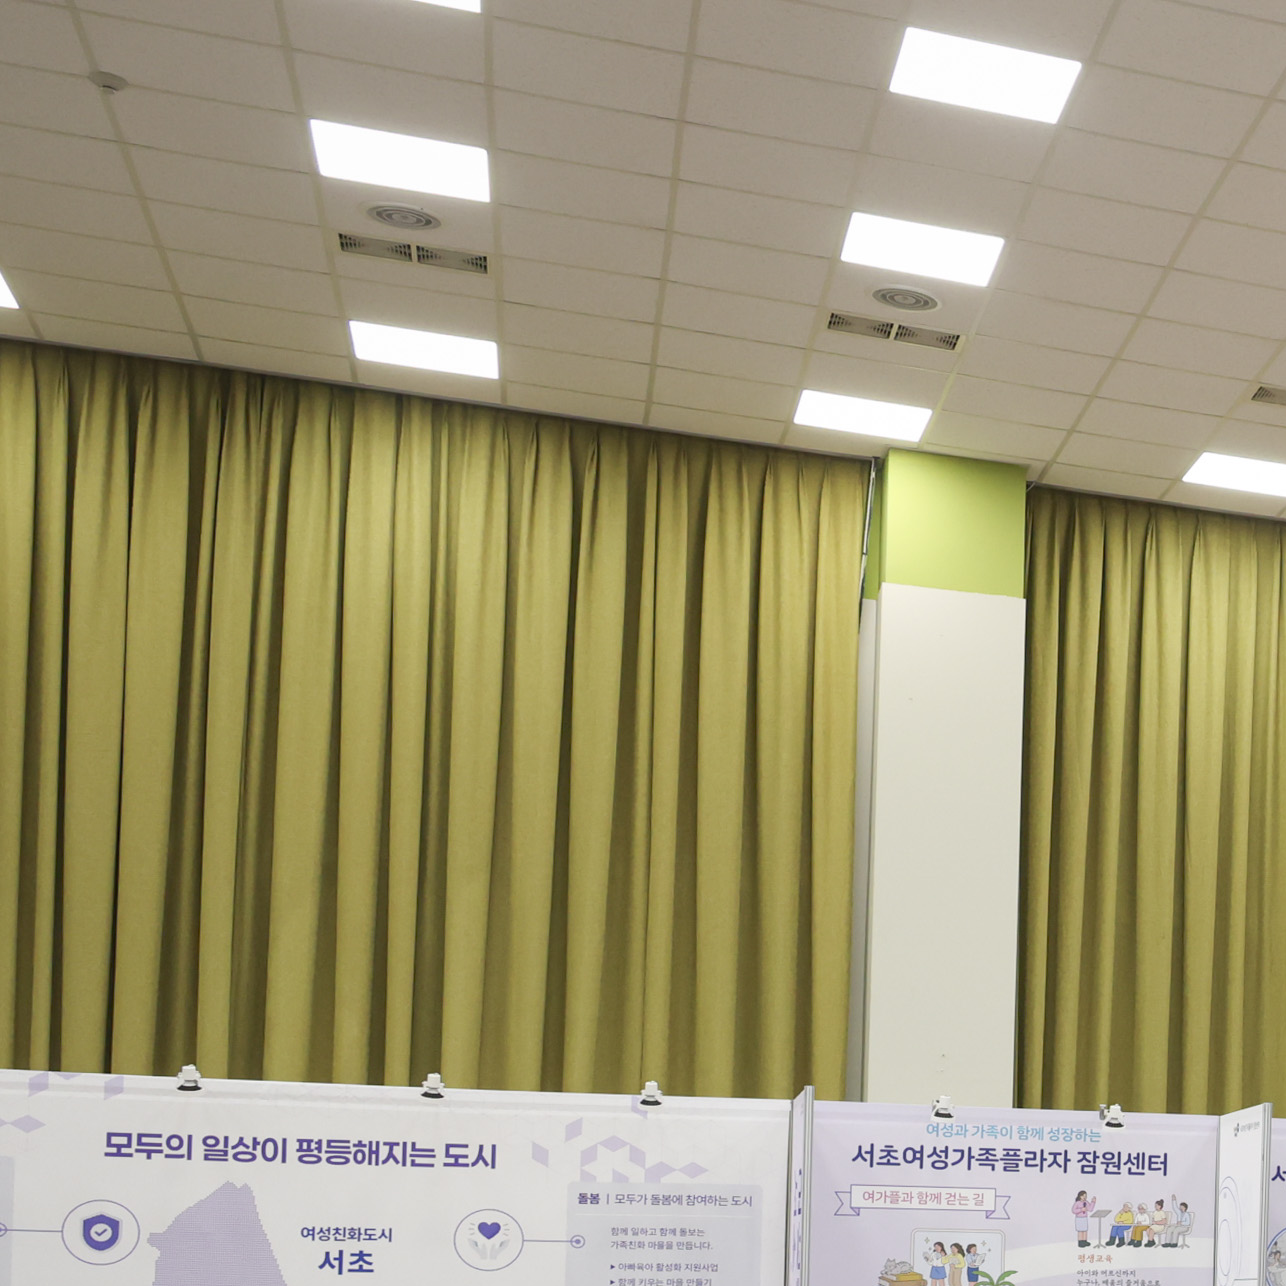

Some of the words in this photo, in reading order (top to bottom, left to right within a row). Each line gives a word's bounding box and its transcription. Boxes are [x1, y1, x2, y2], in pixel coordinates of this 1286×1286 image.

[926, 1123, 969, 1138] 여성과
[971, 1124, 1013, 1140] 가족이
[1017, 1126, 1044, 1141] 함께
[1048, 1127, 1101, 1143] 성장하는
[104, 1132, 193, 1161] 모두의
[202, 1135, 288, 1164] 일상이
[296, 1138, 437, 1168] 평등해지는
[442, 1142, 498, 1170] 도시
[852, 1143, 1071, 1173] 서초여성가족플라자
[1077, 1150, 1168, 1177] 잠원센터
[577, 1192, 601, 1205] 돌봄
[614, 1194, 648, 1206] 모두가
[650, 1194, 683, 1206] 돌봄에
[685, 1194, 728, 1207] 참여하는
[730, 1195, 753, 1207] 도시
[862, 1190, 914, 1205] 여가플과
[916, 1191, 942, 1205] 함께
[945, 1192, 970, 1206] 걷는
[972, 1193, 985, 1207] 길
[300, 1226, 393, 1244] 여성친화도시
[611, 1227, 628, 1237] 함께
[630, 1227, 657, 1237] 일하고
[659, 1227, 677, 1237] 함께
[679, 1228, 705, 1237] 돌보는
[610, 1240, 646, 1250] 가족친화
[647, 1240, 674, 1250] 마을을
[676, 1241, 713, 1251] 만듭니다.
[318, 1249, 375, 1275] 서초
[1078, 1254, 1113, 1263] 평생교육
[618, 1262, 654, 1272] 아빠육아
[655, 1262, 682, 1272] 활성화
[684, 1263, 719, 1273] 지원사업
[618, 1278, 636, 1286] 함께
[638, 1278, 664, 1286] 키우는
[666, 1278, 684, 1286] 마을
